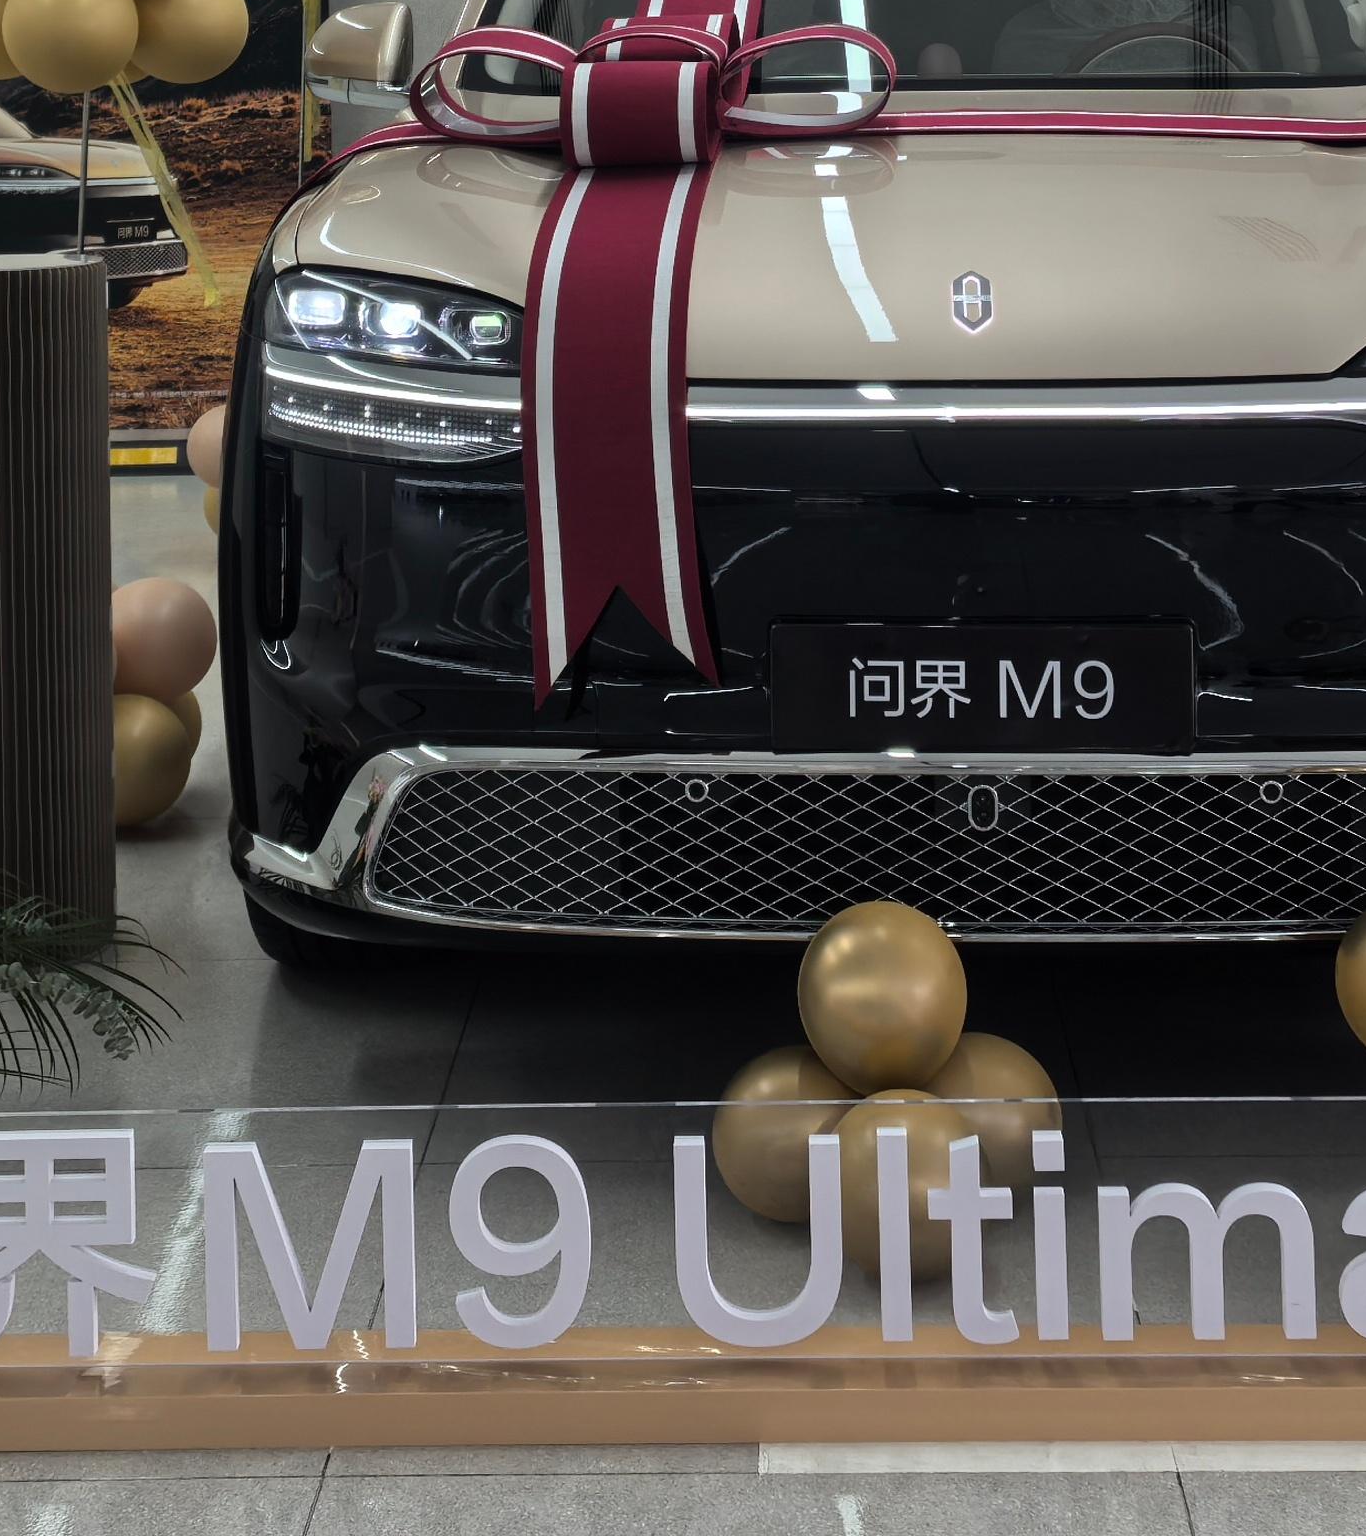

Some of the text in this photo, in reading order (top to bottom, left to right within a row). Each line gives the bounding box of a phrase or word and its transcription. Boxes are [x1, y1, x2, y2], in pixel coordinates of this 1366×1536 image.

[849, 657, 1115, 720] 问界 M9
[203, 1134, 592, 1351] M9
